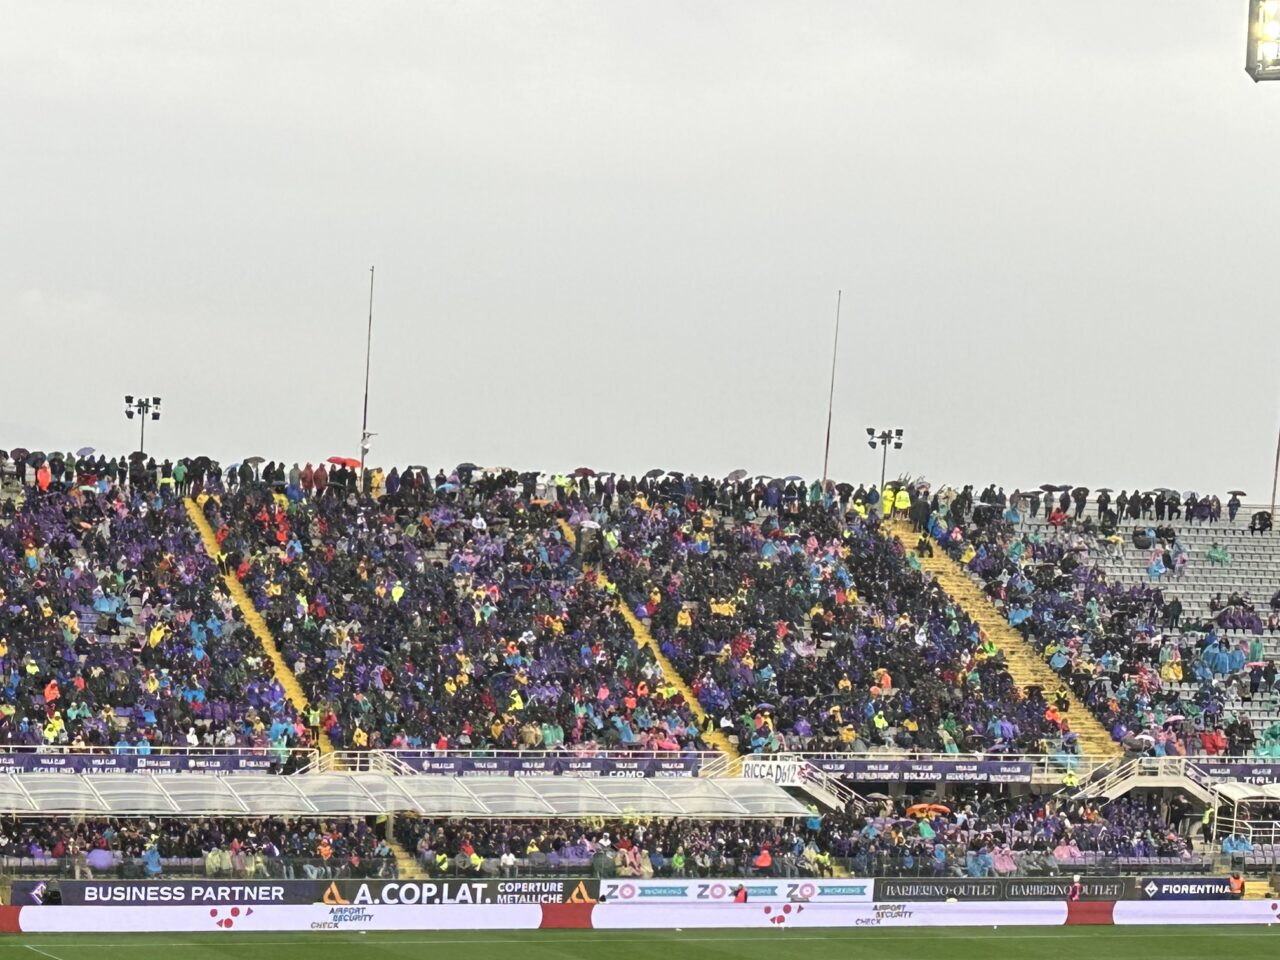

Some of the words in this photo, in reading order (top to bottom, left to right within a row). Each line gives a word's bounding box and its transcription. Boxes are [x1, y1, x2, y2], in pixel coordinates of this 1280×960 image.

[609, 770, 645, 778] COMO
[744, 763, 774, 779] RICCA
[497, 882, 564, 893] COPERTURE
[1161, 884, 1231, 894] FIORENTINA
[84, 886, 185, 902] BUSINESS
[191, 886, 285, 902] PARTNER
[353, 883, 491, 905] A.COP.LAT.
[497, 894, 563, 905] METALLICHE
